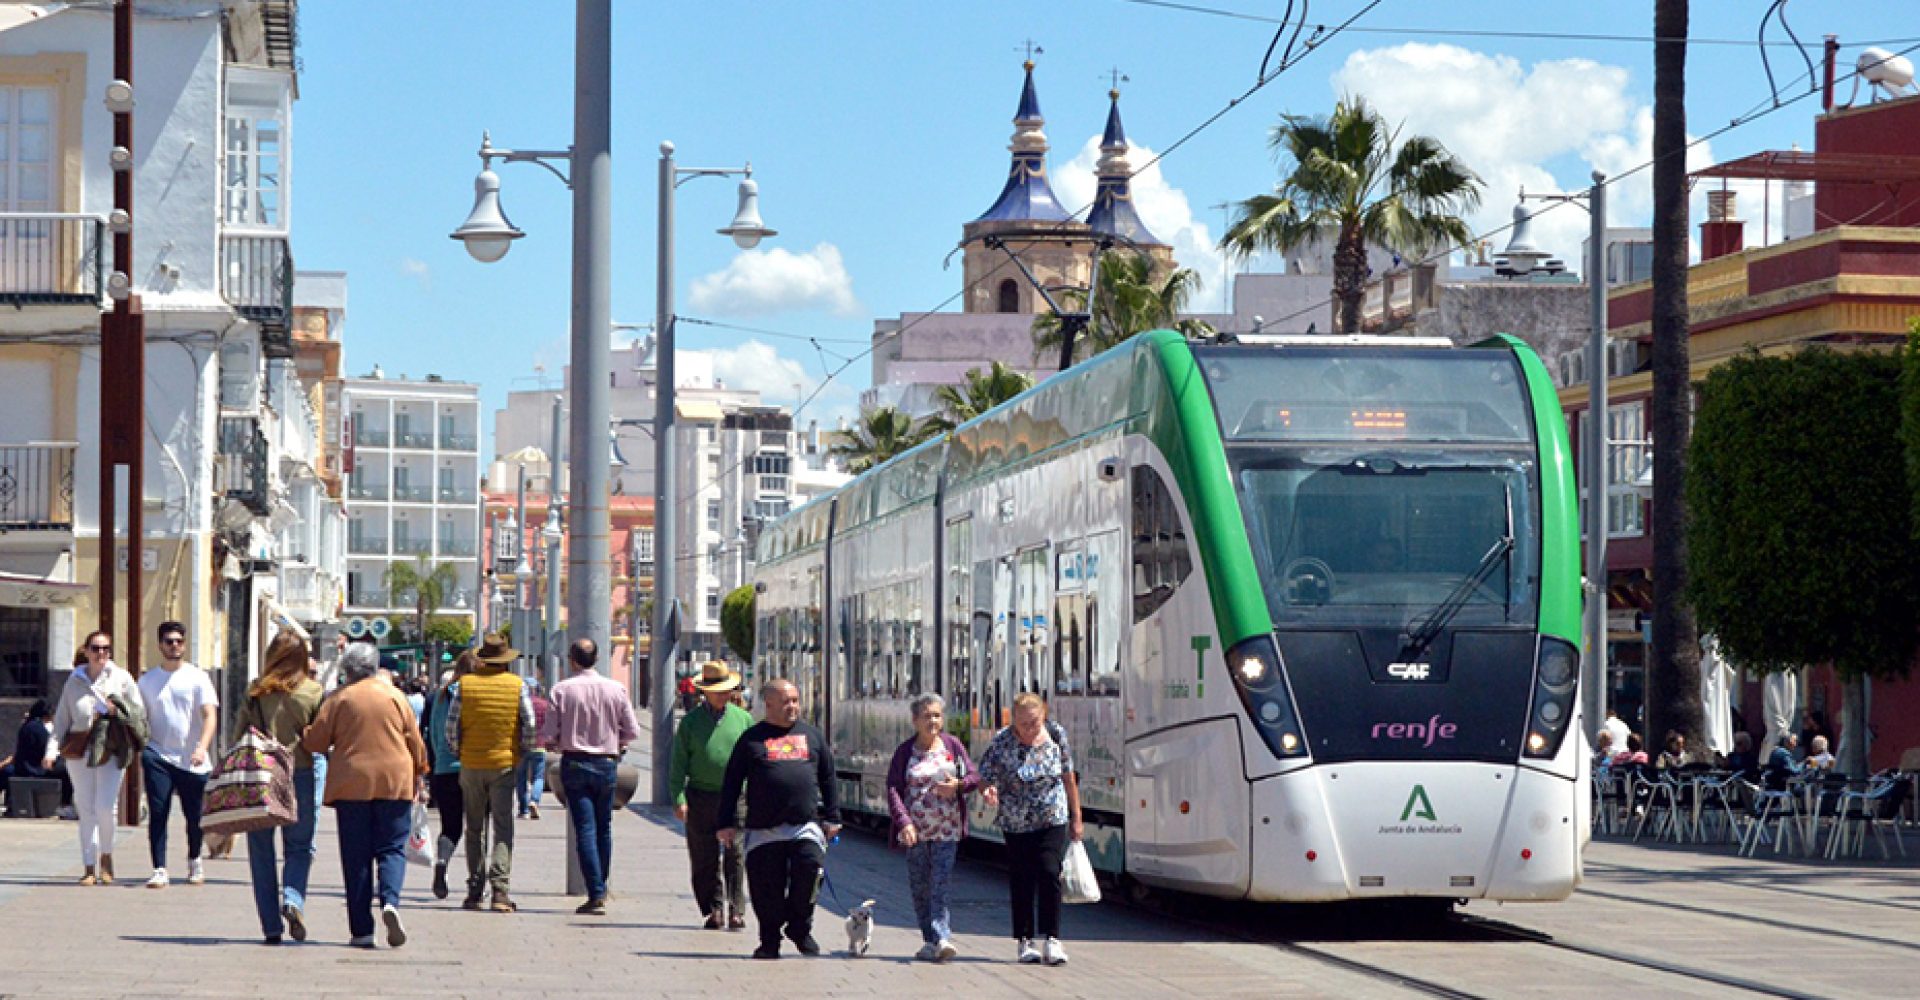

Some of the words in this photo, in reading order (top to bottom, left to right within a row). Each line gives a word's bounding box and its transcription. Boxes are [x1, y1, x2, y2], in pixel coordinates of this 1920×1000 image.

[1387, 662, 1430, 680] CAF
[1371, 714, 1457, 748] renfe
[1378, 823, 1403, 834] Junta
[1405, 823, 1416, 834] de
